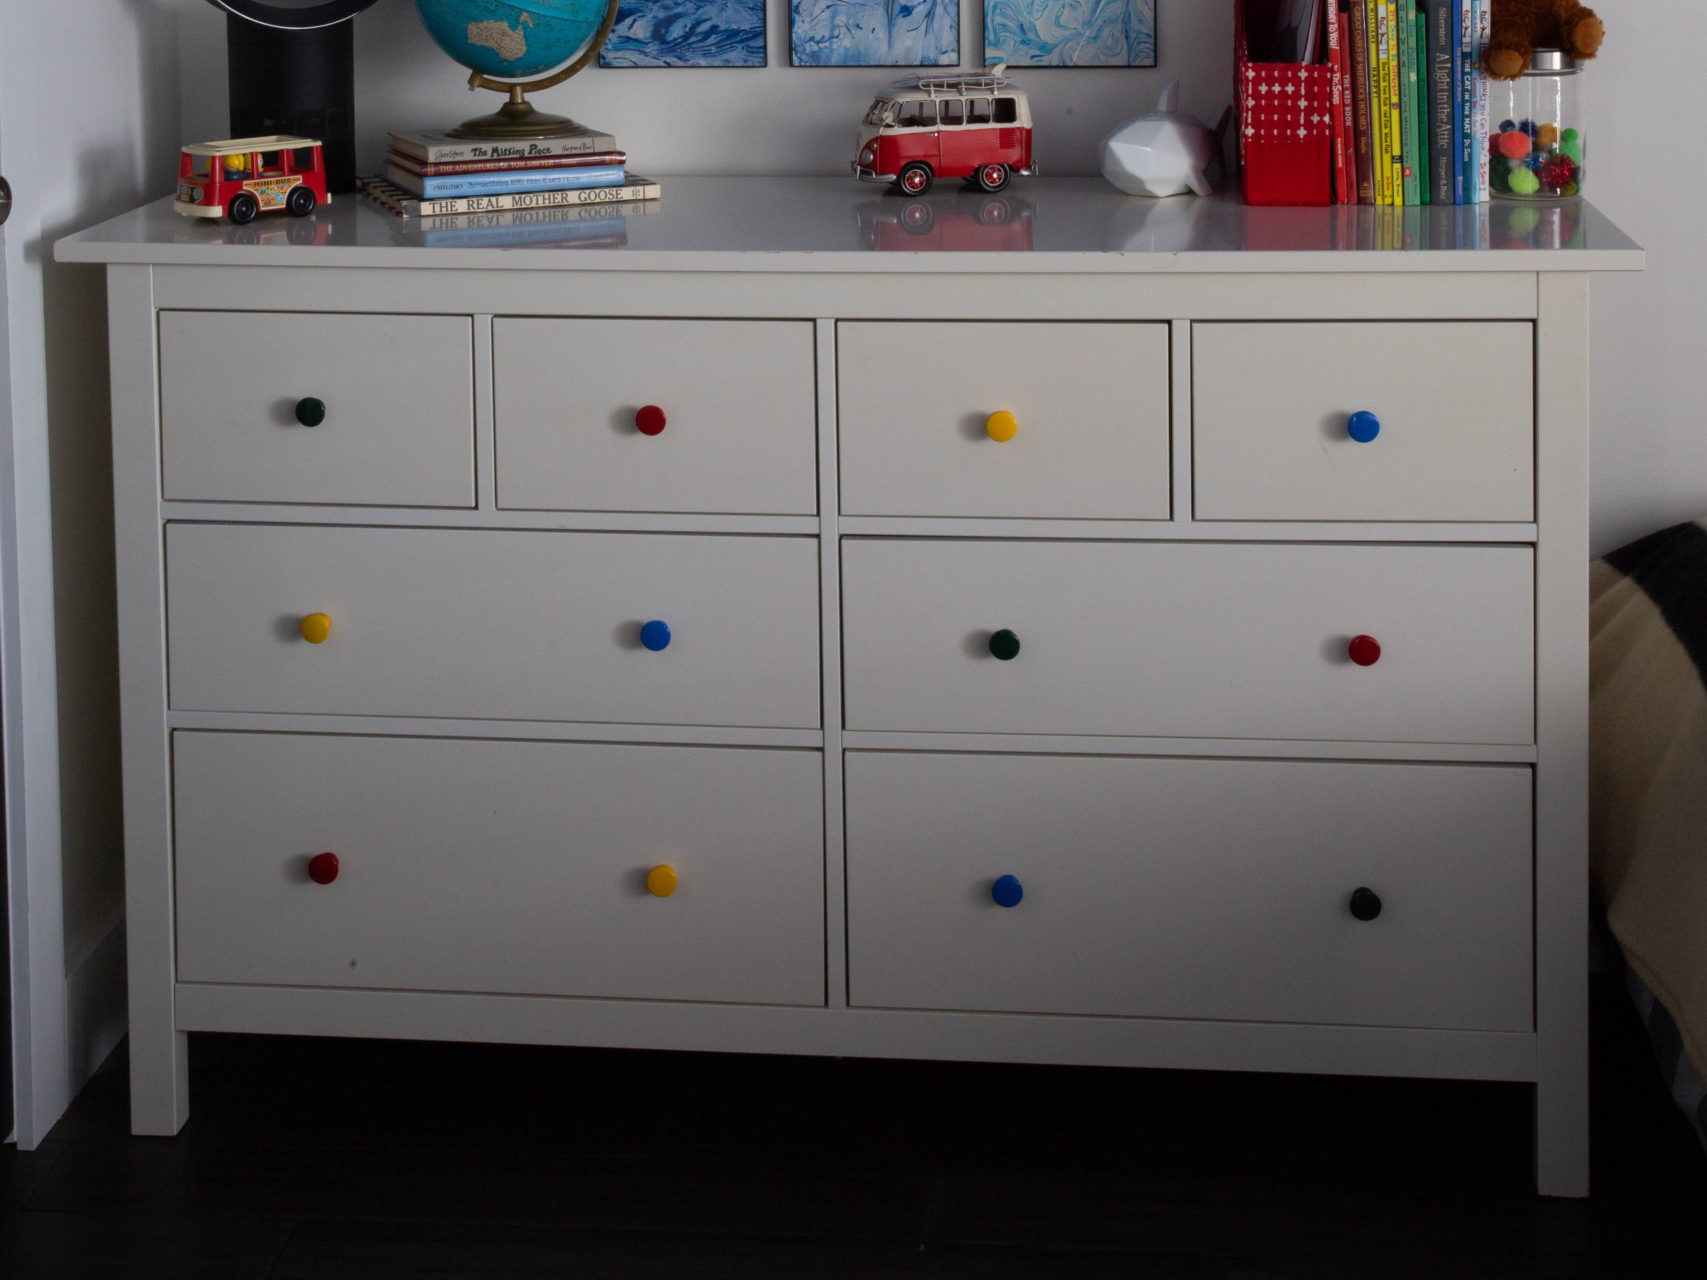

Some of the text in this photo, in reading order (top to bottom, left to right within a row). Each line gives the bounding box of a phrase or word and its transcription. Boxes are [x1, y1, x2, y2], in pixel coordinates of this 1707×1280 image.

[1353, 7, 1361, 29] GREAT
[1354, 31, 1362, 52] CASES
[1436, 53, 1450, 61] A
[1356, 63, 1366, 100] SHERLOCK
[1433, 63, 1450, 90] Light
[1332, 86, 1341, 104] Seuss
[1464, 92, 1470, 100] IN
[1359, 101, 1367, 130] HOLMES
[1437, 105, 1450, 121] the
[1437, 123, 1451, 149] Attic
[471, 147, 488, 158] The
[490, 145, 525, 158] Missing
[528, 144, 552, 155] Piece
[440, 163, 452, 173] THE
[453, 160, 498, 172] ADVENTURES
[511, 159, 526, 169] TOM
[468, 179, 509, 190] Something
[428, 201, 457, 214] THE
[467, 198, 504, 212] REAL
[512, 193, 568, 208] MOTHER
[578, 188, 623, 202] GOOSE
